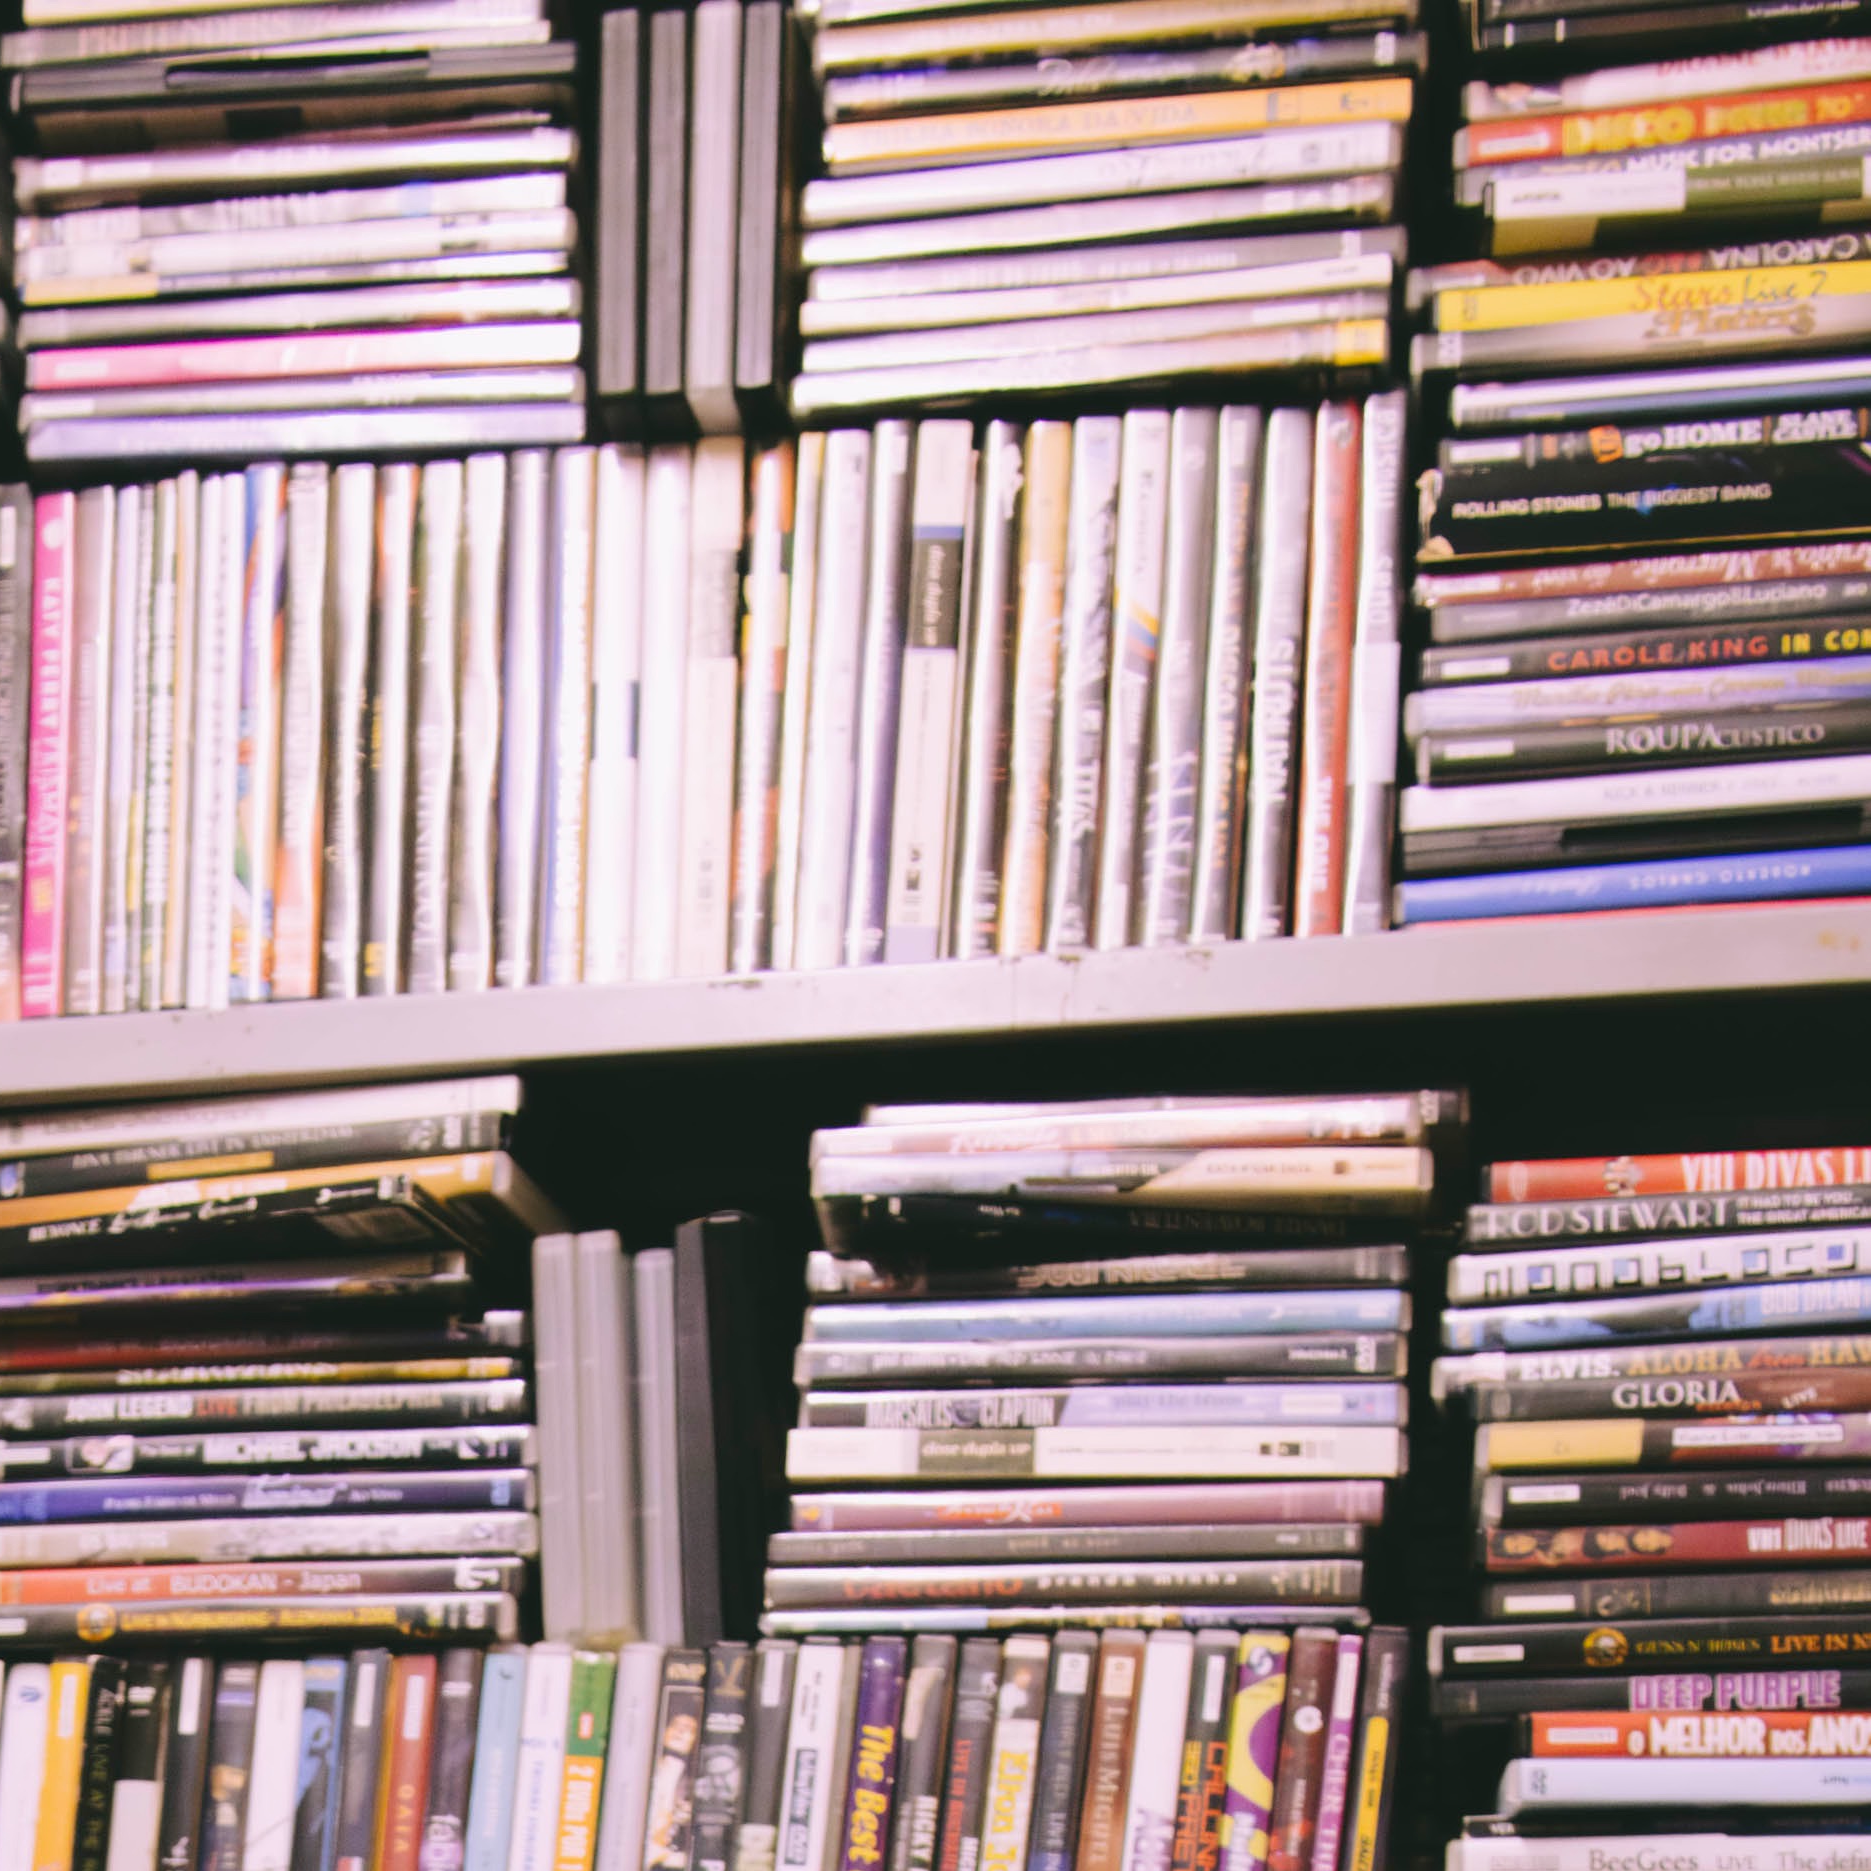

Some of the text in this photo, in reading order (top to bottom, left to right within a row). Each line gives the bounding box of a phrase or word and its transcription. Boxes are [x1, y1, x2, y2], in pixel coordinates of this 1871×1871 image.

[1704, 141, 1753, 165] FOR
[1453, 499, 1531, 520] ROLLING
[1533, 494, 1601, 515] STONES
[1607, 491, 1641, 509] THE
[1549, 642, 1674, 671] CAROLE
[1686, 637, 1767, 660] KING
[1781, 635, 1811, 654] IN
[1744, 1152, 1842, 1188] DIVAS
[1568, 1198, 1731, 1233] STEWART
[1612, 1379, 1741, 1410] GLORIA
[86, 1572, 127, 1595] Live
[170, 1572, 278, 1594] BUDOKAN
[298, 1570, 362, 1593] Japan
[1771, 1633, 1818, 1654] LIVE
[1630, 1670, 1840, 1710] DEEP PURPLE
[856, 1723, 895, 1783] The
[1649, 1716, 1765, 1755] MELHOR
[849, 1786, 888, 1867] Best
